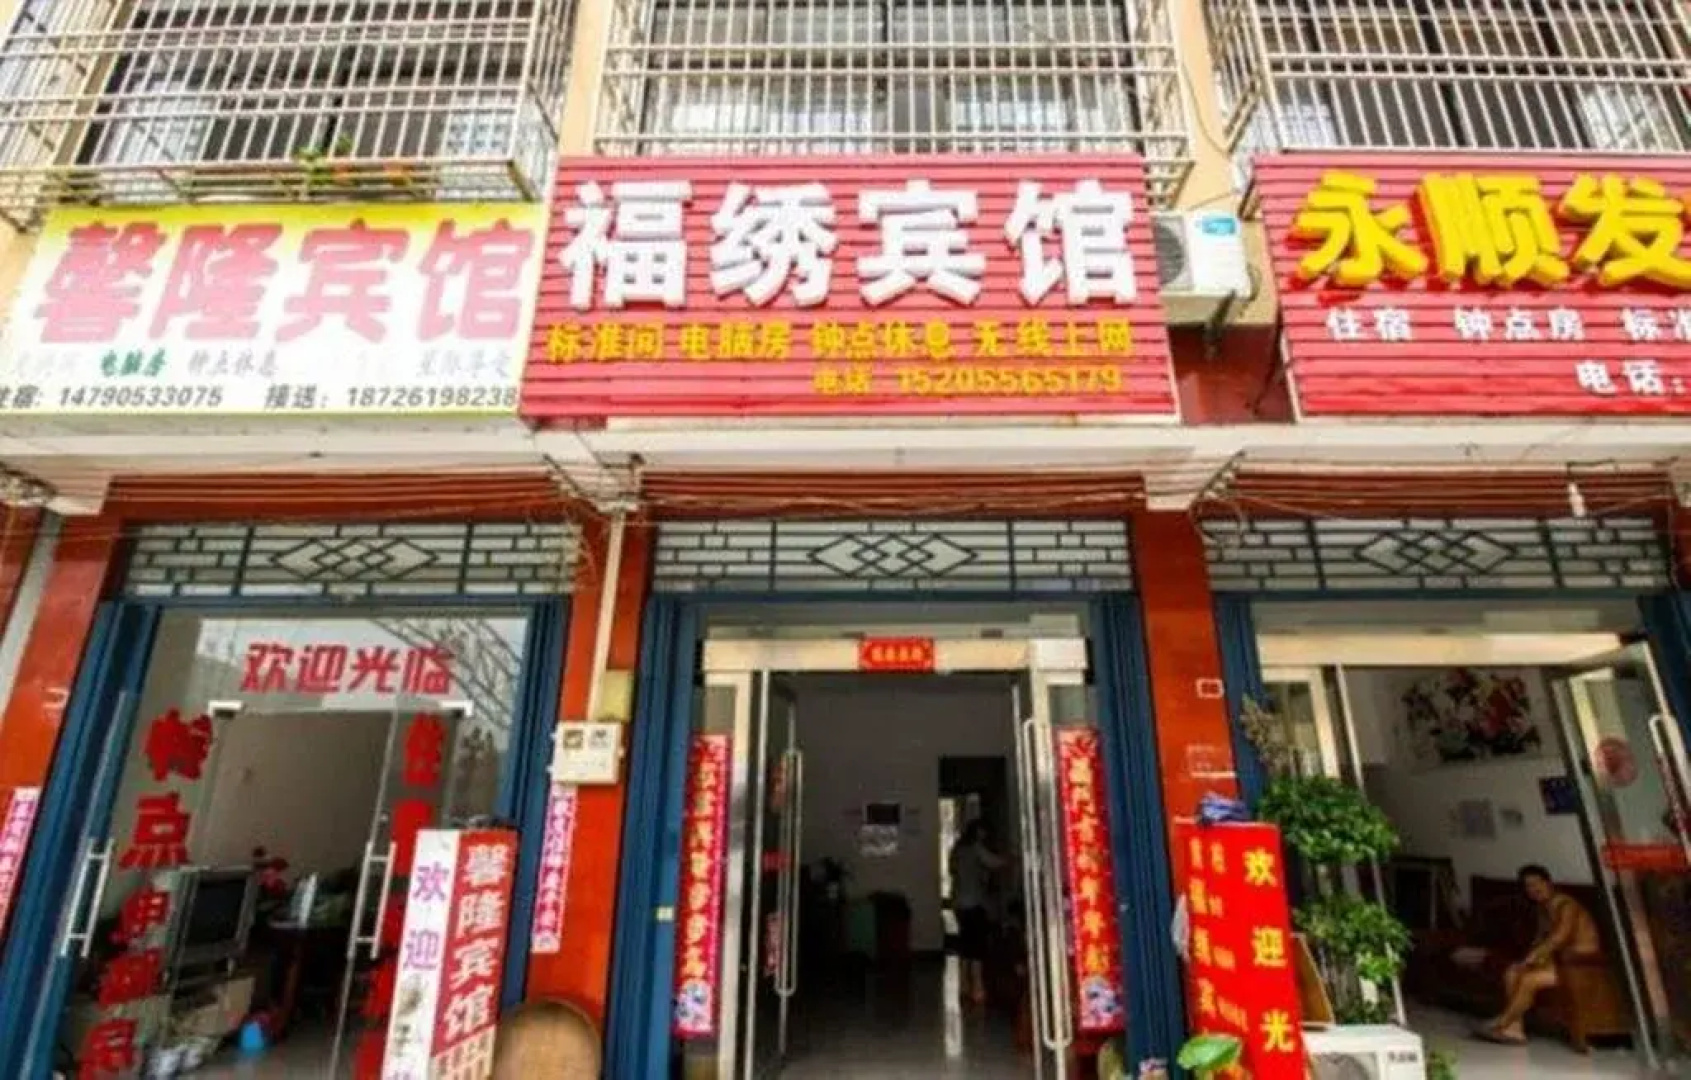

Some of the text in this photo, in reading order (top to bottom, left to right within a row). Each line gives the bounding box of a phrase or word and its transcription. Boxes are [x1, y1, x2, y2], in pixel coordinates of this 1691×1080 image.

[560, 181, 1138, 309] 福绣宾馆
[1295, 170, 1691, 288] 永顺发
[34, 219, 534, 344] 馨隆宾馆
[548, 317, 1133, 362] 标准间 电脑房 钟点休息 无线上网
[1326, 306, 1413, 341] 住宿
[1453, 306, 1585, 341] 钟点房
[60, 387, 224, 406] 14790533075
[347, 386, 517, 407] 18726198238
[812, 364, 873, 394] 电话
[240, 640, 456, 695] 欢迎光临
[402, 861, 450, 970] 欢迎
[440, 843, 509, 1042] 馨隆宾馆
